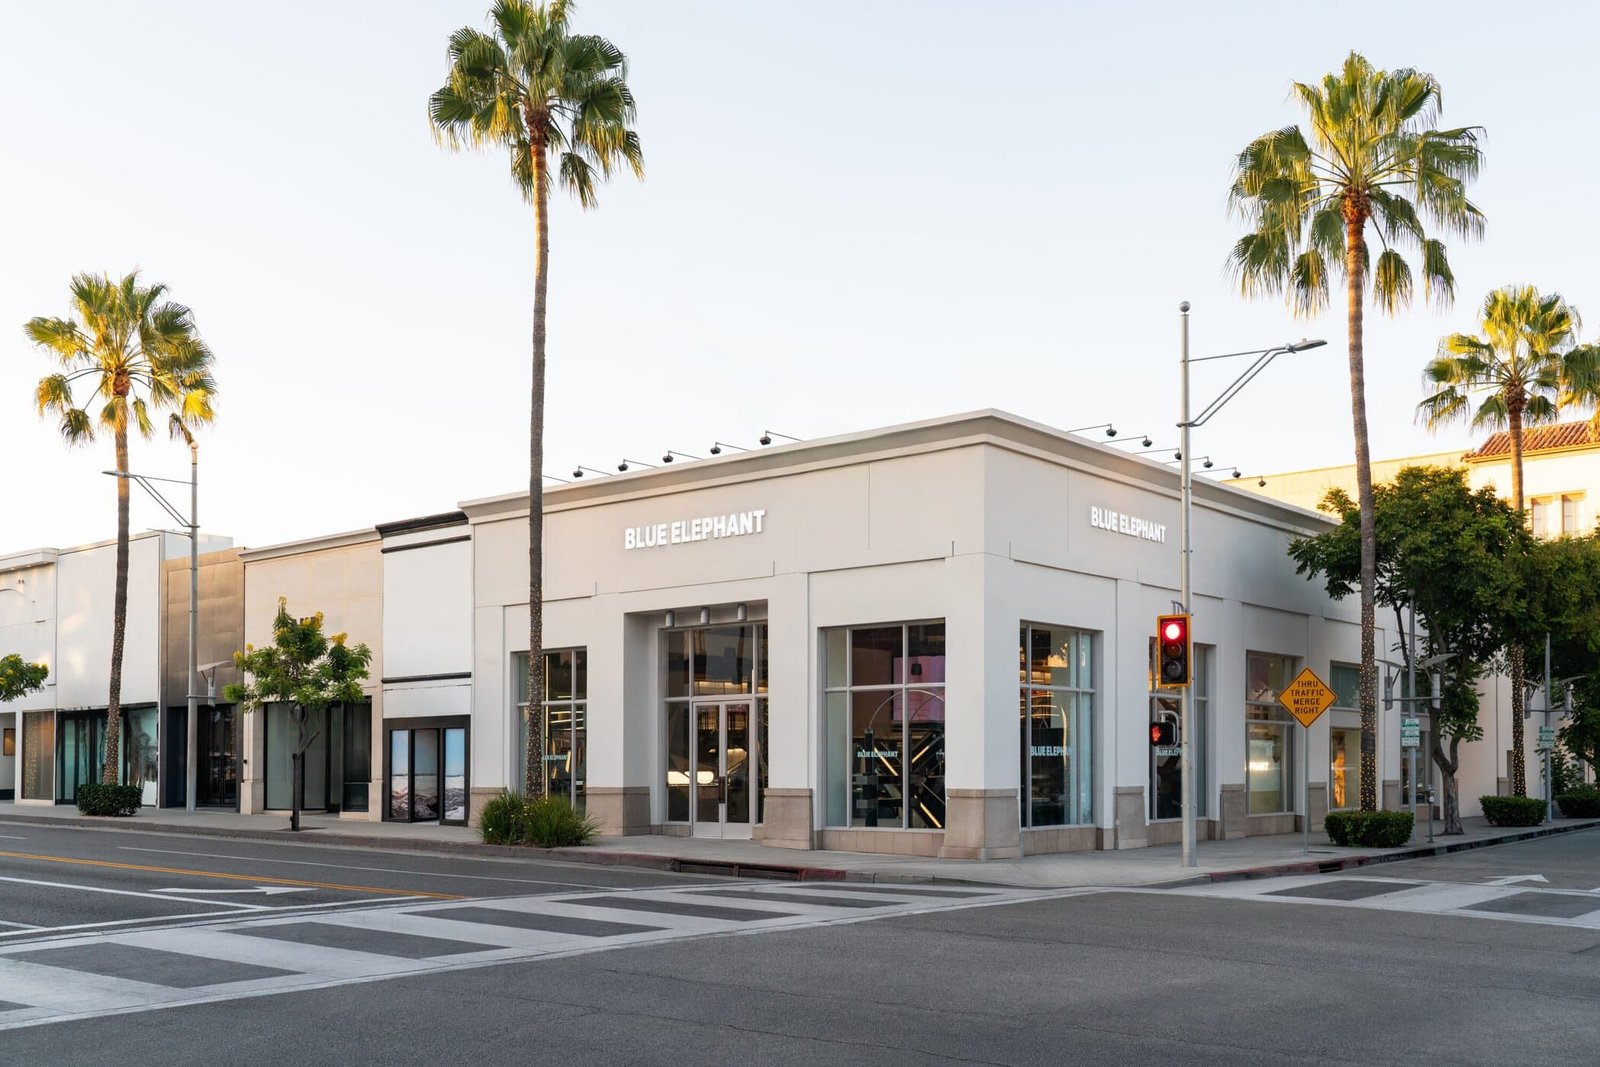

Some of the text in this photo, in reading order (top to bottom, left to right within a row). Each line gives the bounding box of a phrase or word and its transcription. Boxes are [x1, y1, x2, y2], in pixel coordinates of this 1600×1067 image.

[1091, 506, 1167, 543] BLUE ELEPHANT
[625, 509, 766, 550] BLUE ELEPHANT
[1297, 680, 1318, 688] THRU
[1290, 689, 1325, 697] TRAFFIC
[1293, 697, 1321, 706] MERGE
[1294, 706, 1319, 714] RIGHT
[1031, 745, 1046, 757] BLUE
